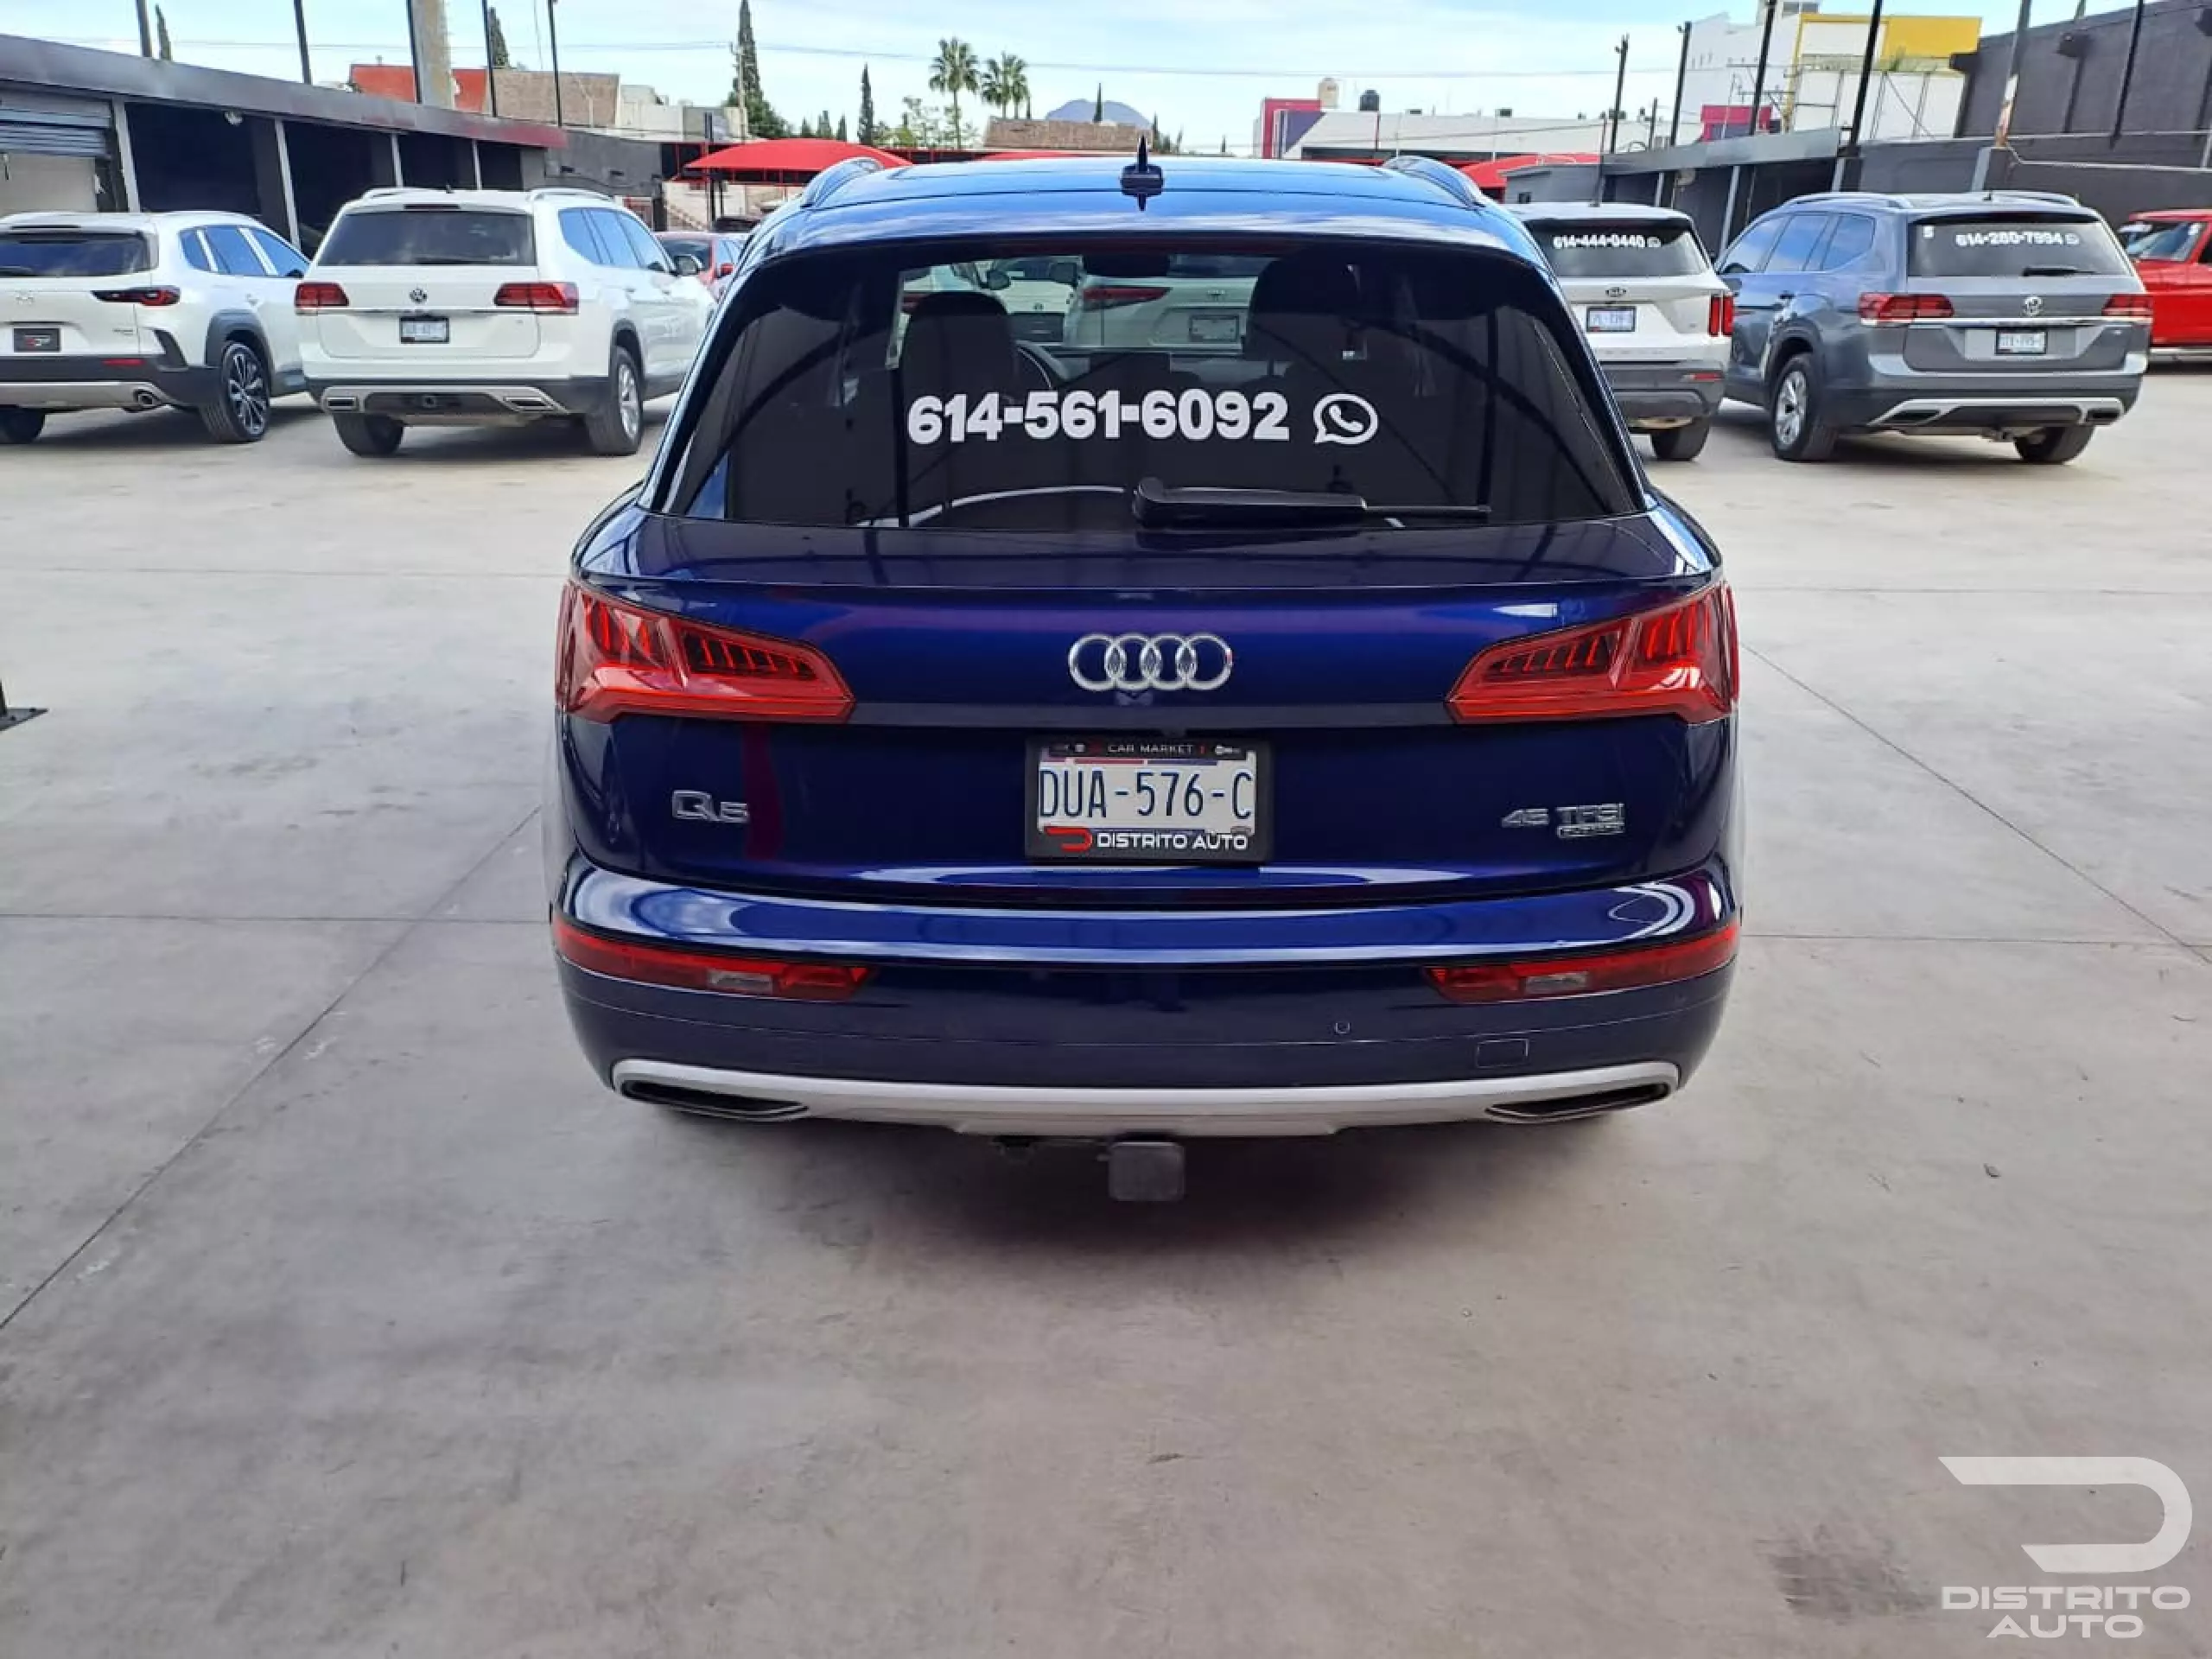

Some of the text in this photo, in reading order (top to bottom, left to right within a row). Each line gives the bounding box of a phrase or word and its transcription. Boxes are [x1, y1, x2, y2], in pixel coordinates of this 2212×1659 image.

[907, 389, 1290, 444] 614-561-6092
[1107, 743, 1193, 754] CAR MARKET
[671, 789, 749, 823] Q5
[1039, 769, 1252, 819] DUA-576-C
[1096, 831, 1249, 850] DISTRITO AUTO
